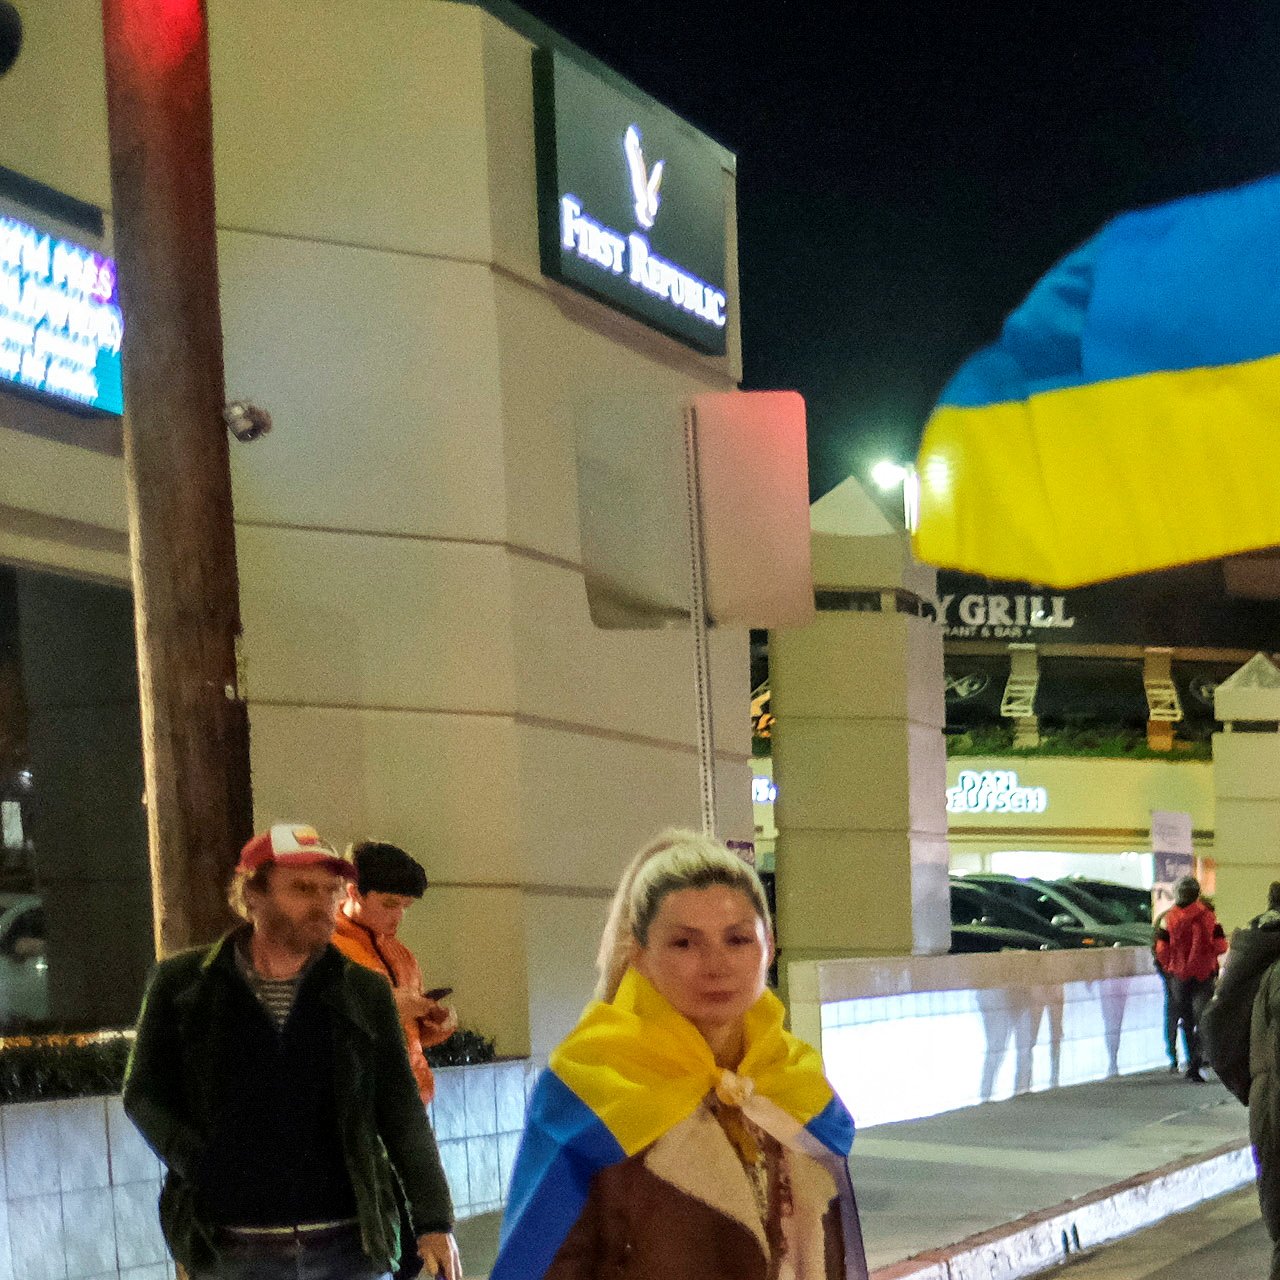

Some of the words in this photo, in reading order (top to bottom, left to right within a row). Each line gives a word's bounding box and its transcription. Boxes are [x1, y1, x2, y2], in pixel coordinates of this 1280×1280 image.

[560, 194, 626, 274] FIRST
[627, 230, 726, 328] REPUBLIC
[958, 593, 1075, 628] GRILL
